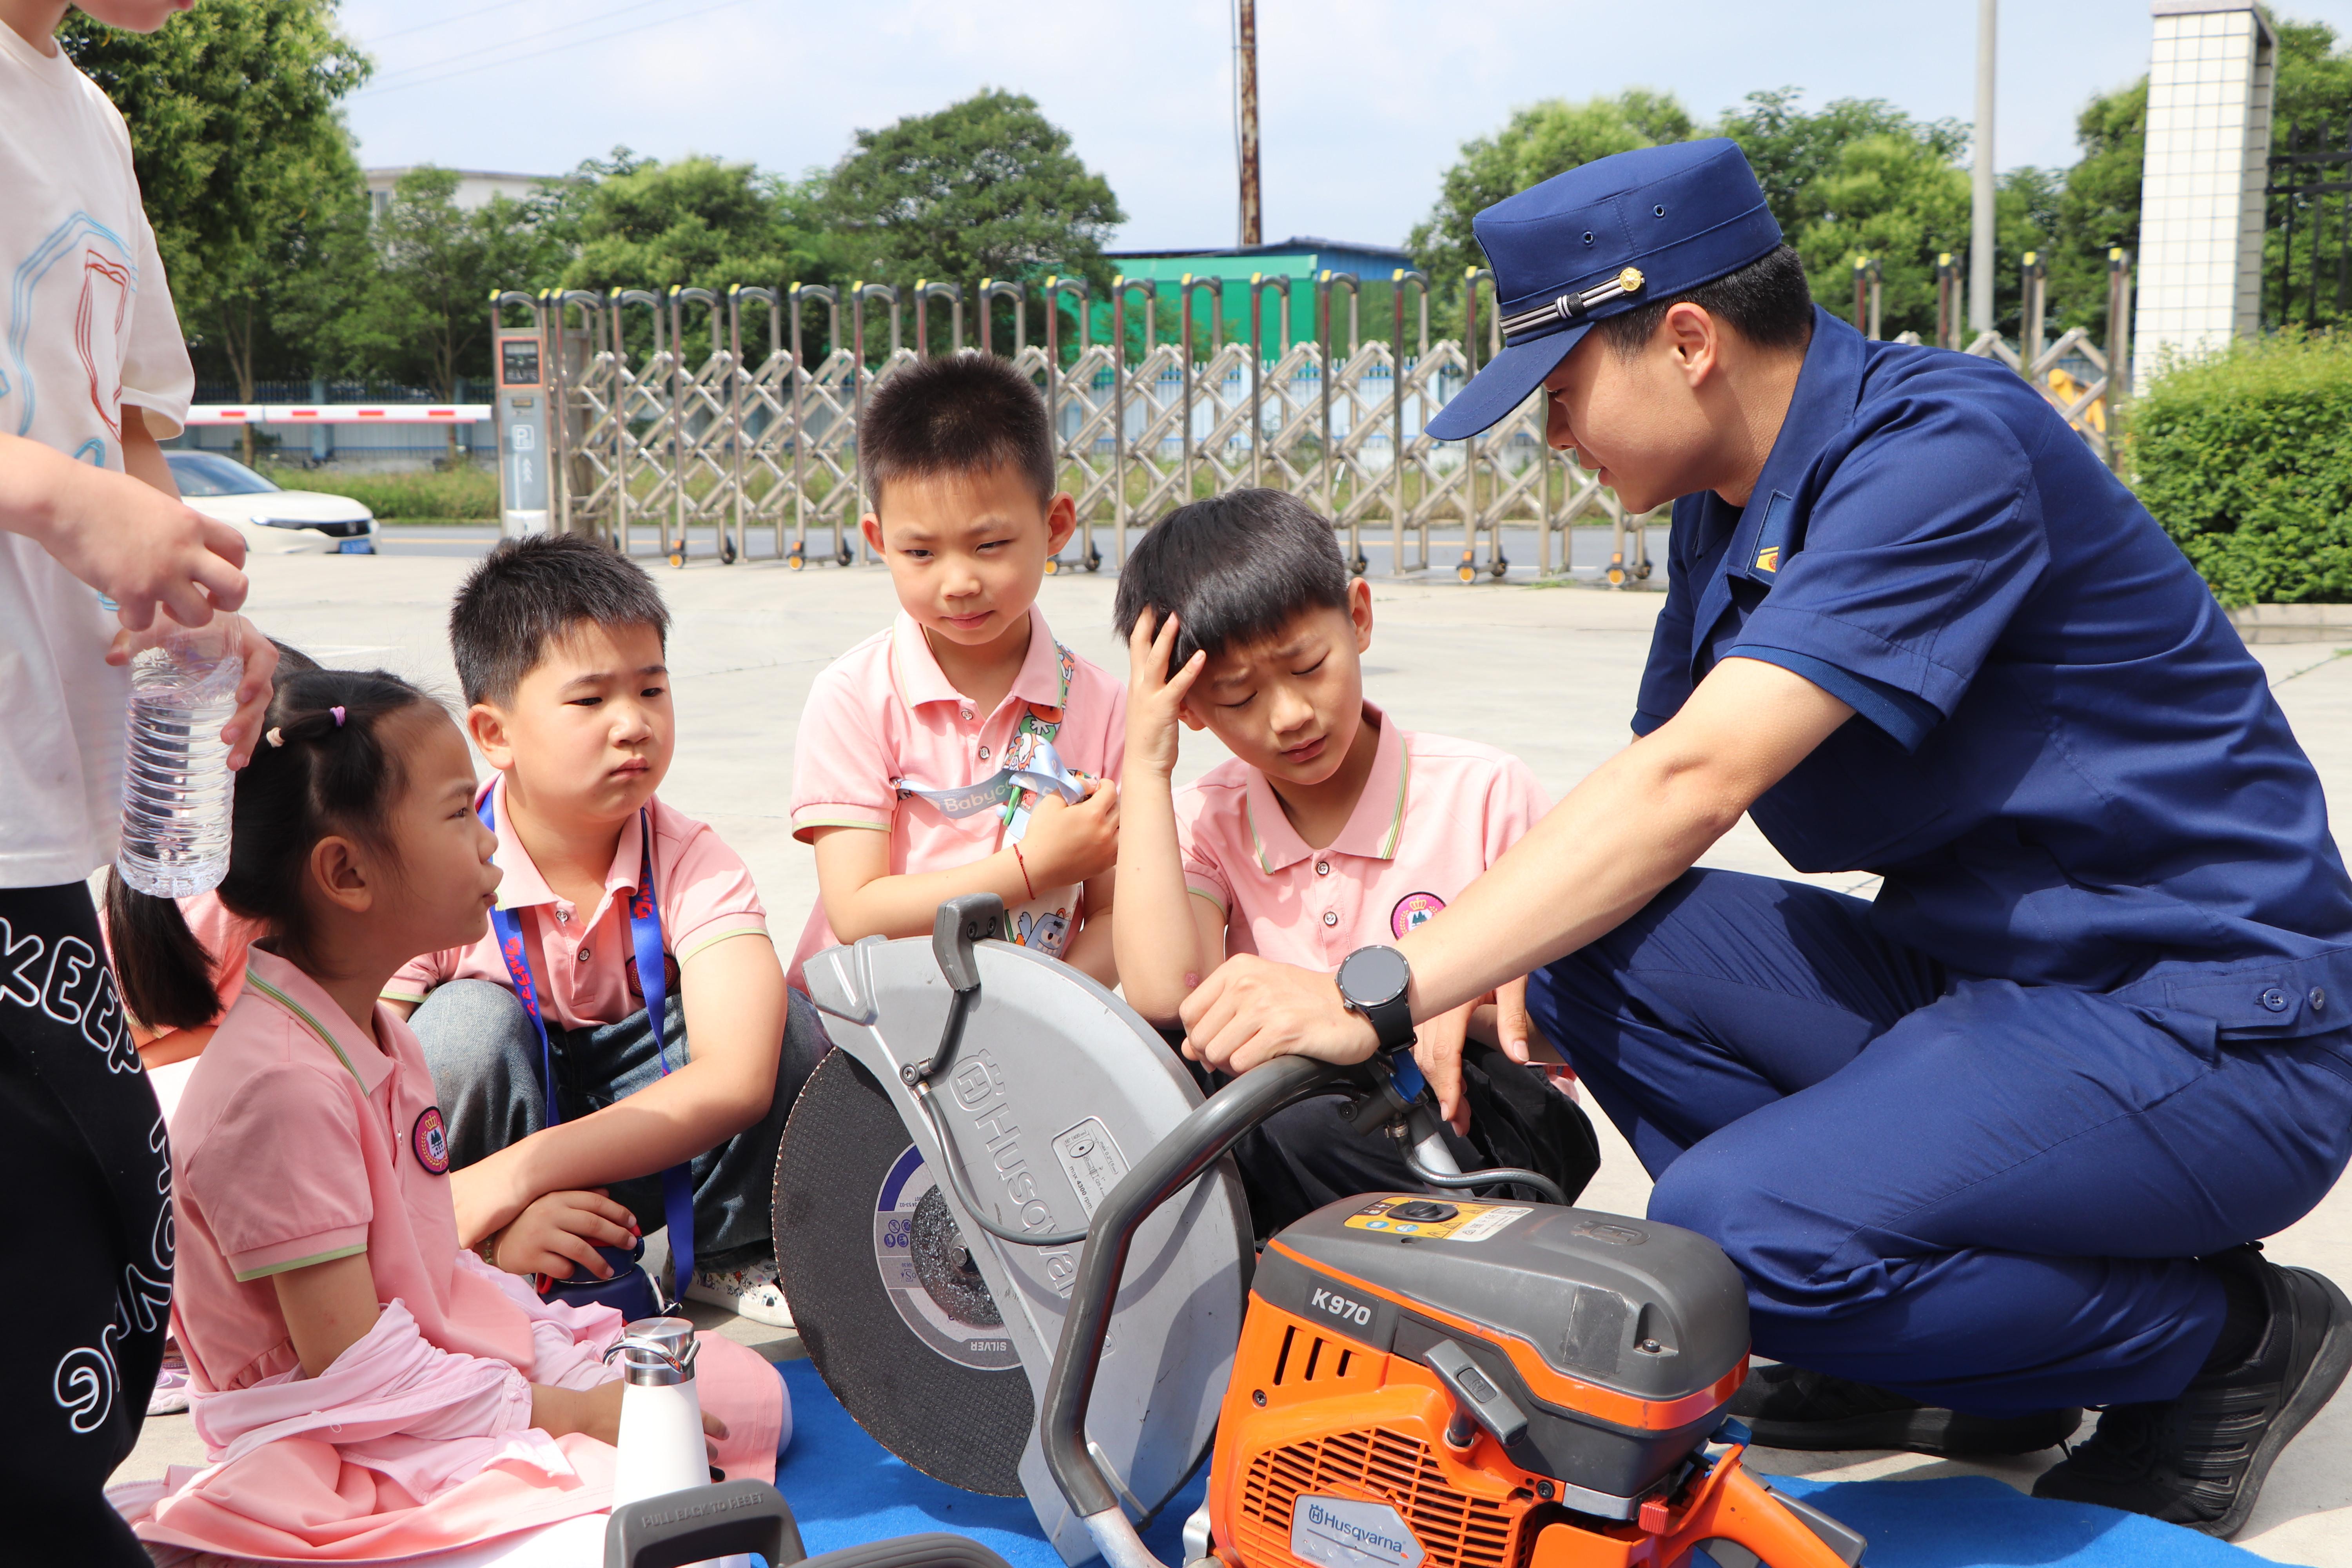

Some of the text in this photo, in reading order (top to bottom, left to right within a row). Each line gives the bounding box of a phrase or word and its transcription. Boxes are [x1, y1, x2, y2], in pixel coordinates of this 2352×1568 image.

[1069, 1165, 1093, 1210] max 4300 rpm
[971, 1341, 1007, 1351] SILVER
[641, 1492, 765, 1529] PULL BACK TO RESET
[1324, 1512, 1403, 1553] Husqvarna
[1302, 1550, 1327, 1563] patented
